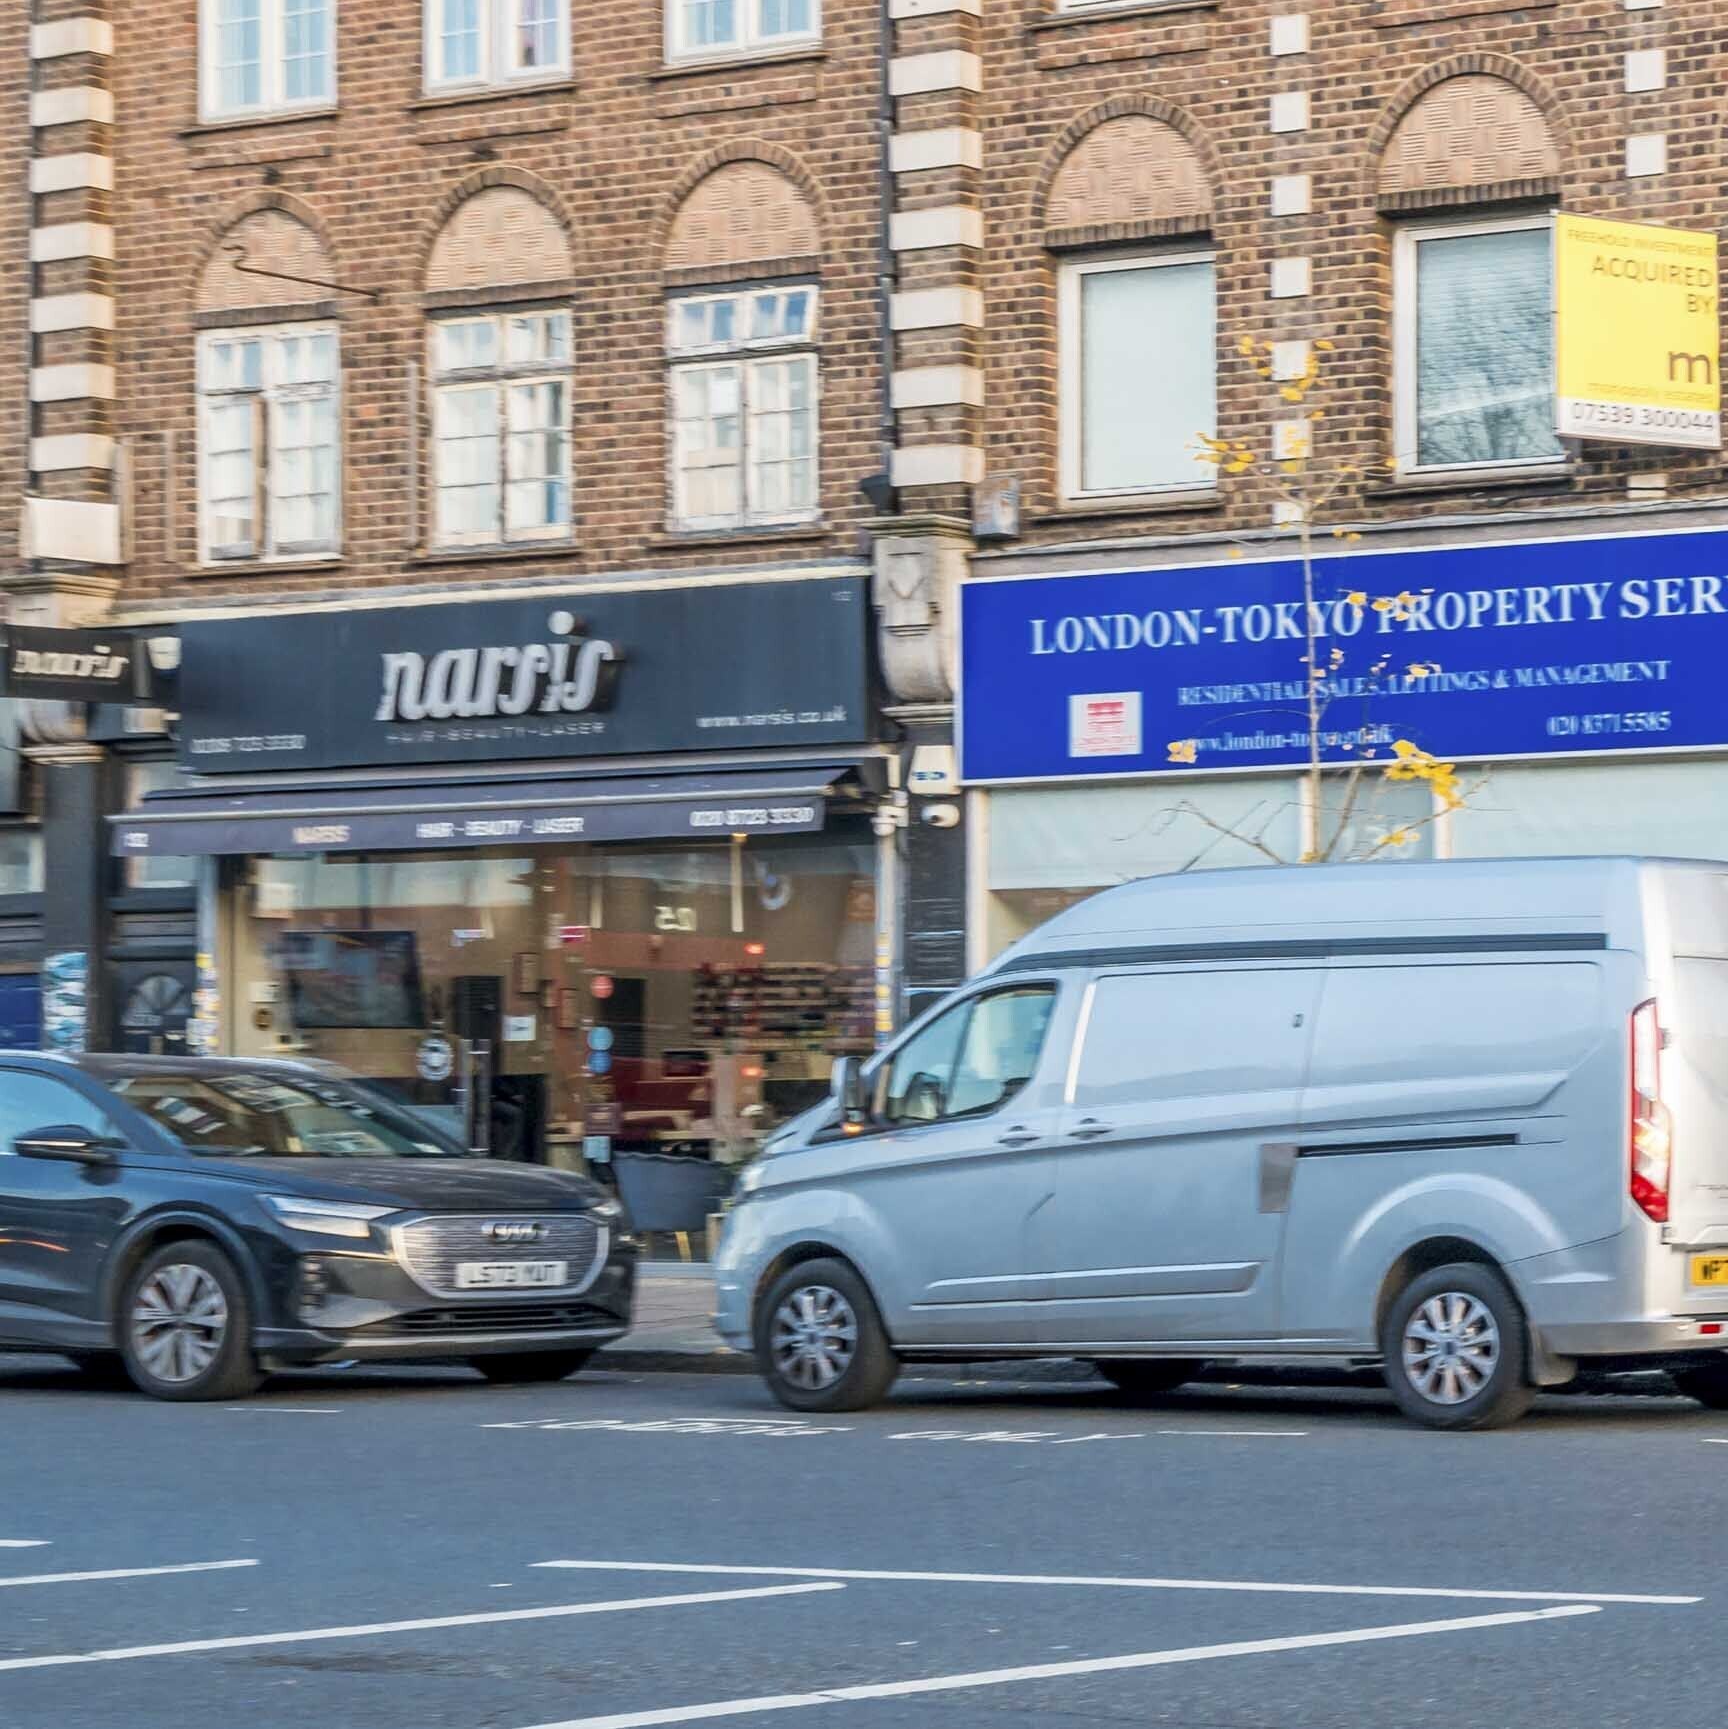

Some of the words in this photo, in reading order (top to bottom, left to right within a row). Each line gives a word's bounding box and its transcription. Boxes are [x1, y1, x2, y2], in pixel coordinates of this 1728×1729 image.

[1593, 255, 1713, 288] ACQUIRED
[1687, 293, 1715, 313] BY
[1573, 402, 1632, 424] 07539
[1640, 408, 1714, 430] 300044
[1029, 598, 1364, 656] LONDON-TOKYO
[1377, 581, 1613, 636] PROPERTY
[1177, 681, 1308, 707] RESIDENTIAL
[1492, 670, 1511, 690] &
[1514, 660, 1672, 688] MANAGEMENT
[1546, 714, 1578, 737] 020
